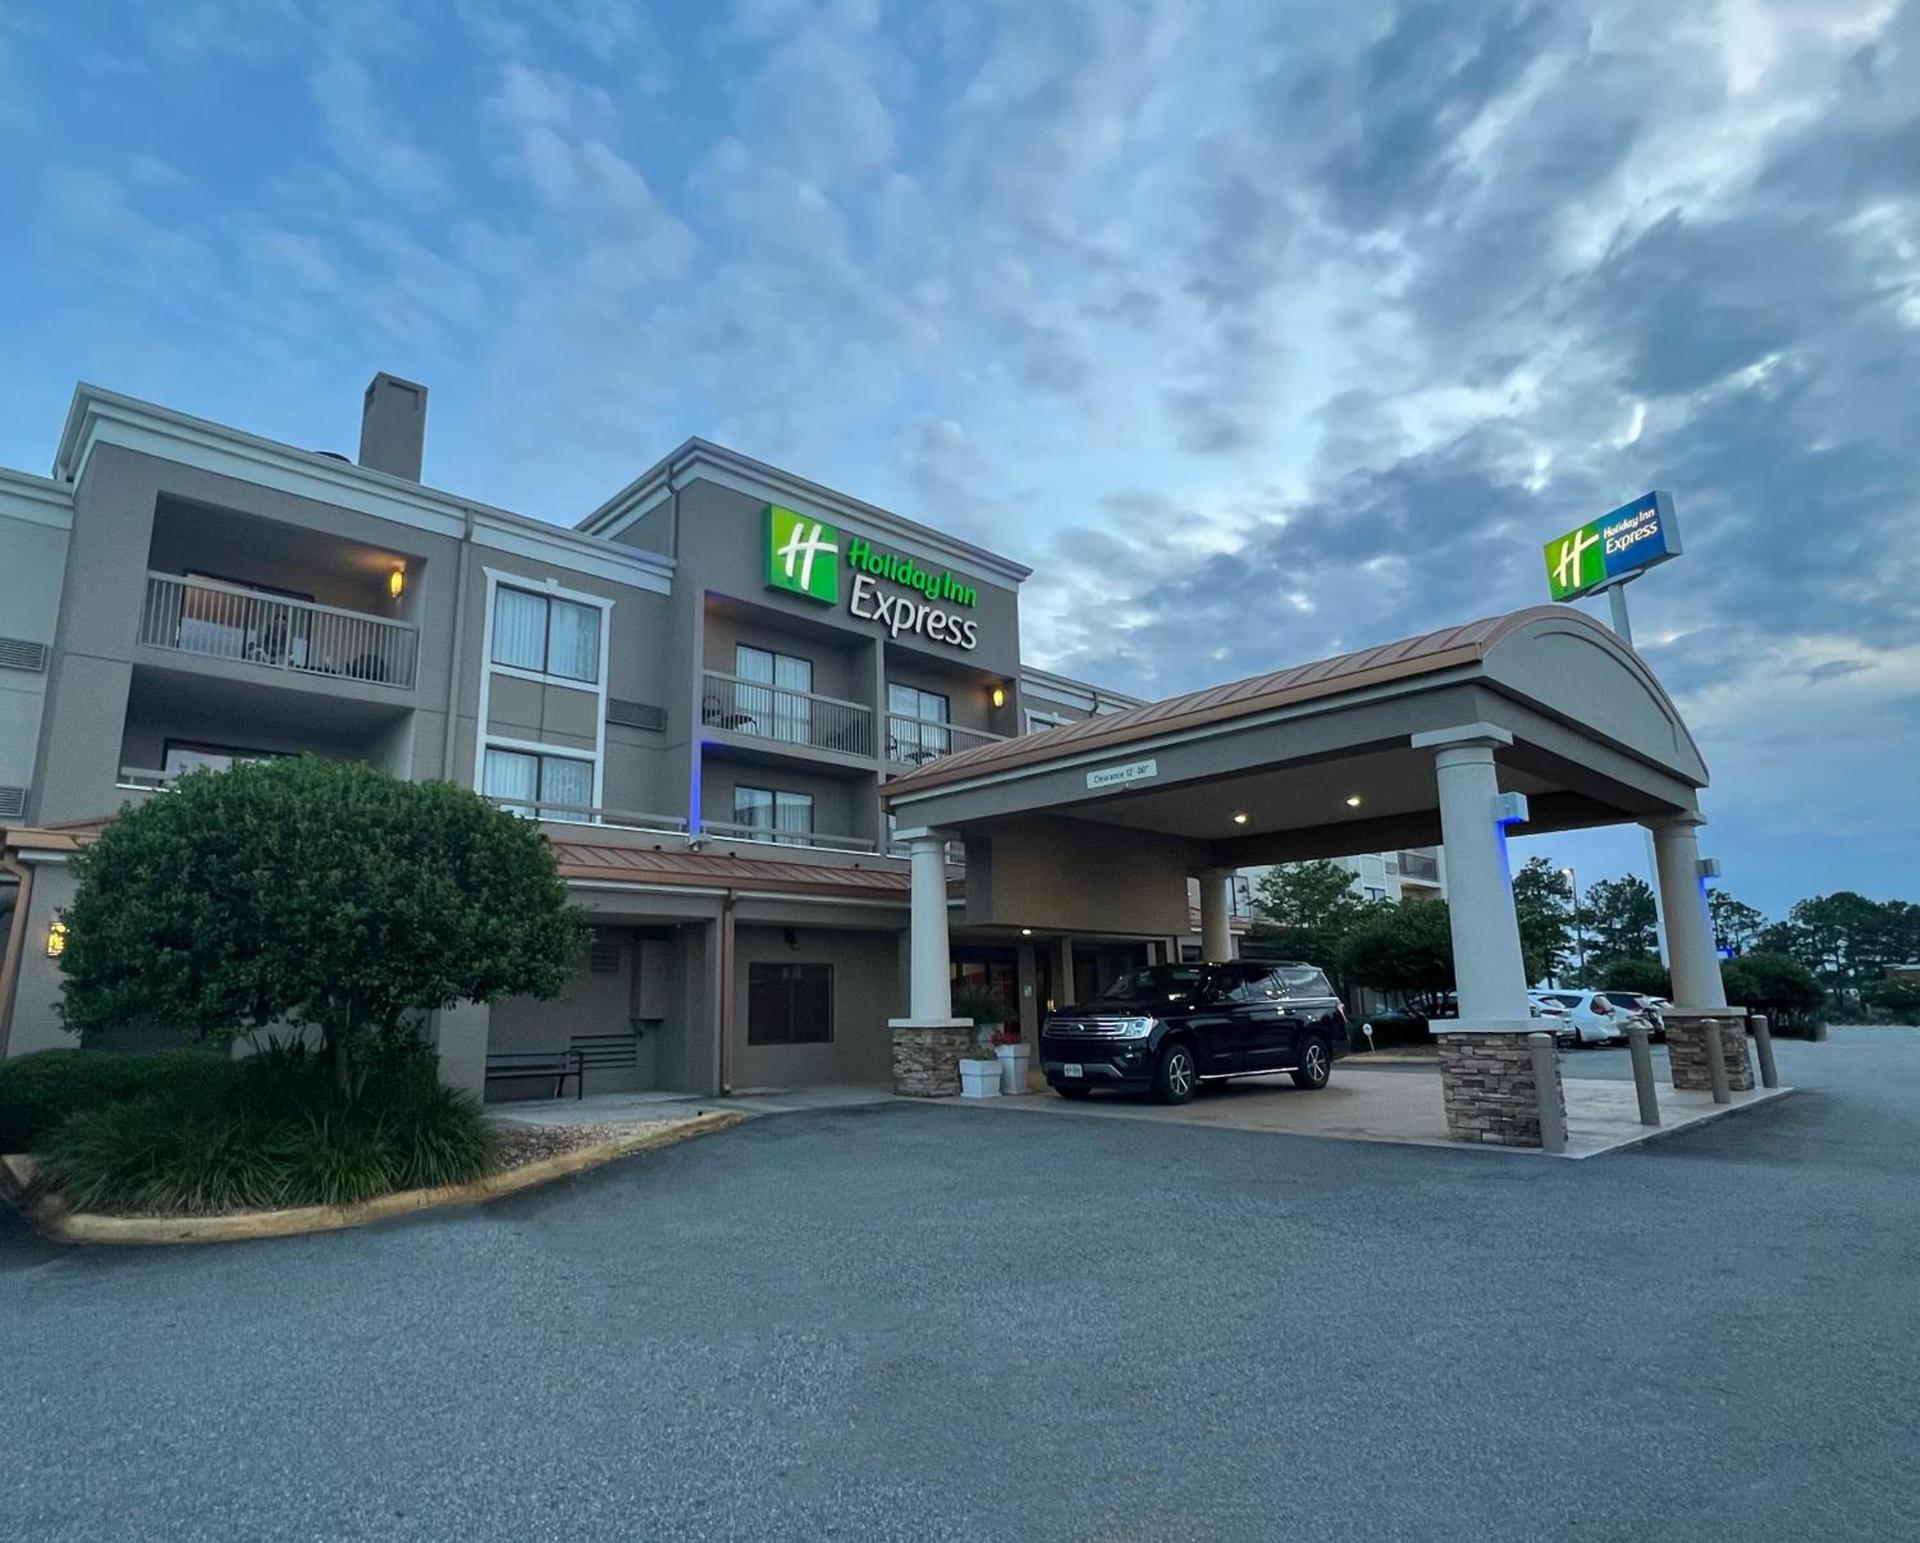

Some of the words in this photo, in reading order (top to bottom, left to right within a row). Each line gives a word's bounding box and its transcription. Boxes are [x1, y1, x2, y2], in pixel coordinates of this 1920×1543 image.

[1603, 516, 1639, 540] Holiday
[1639, 508, 1656, 523] Inn
[1606, 521, 1658, 554] Express
[848, 537, 943, 600] Holiday
[943, 572, 978, 608] Inn
[850, 573, 978, 650] Express
